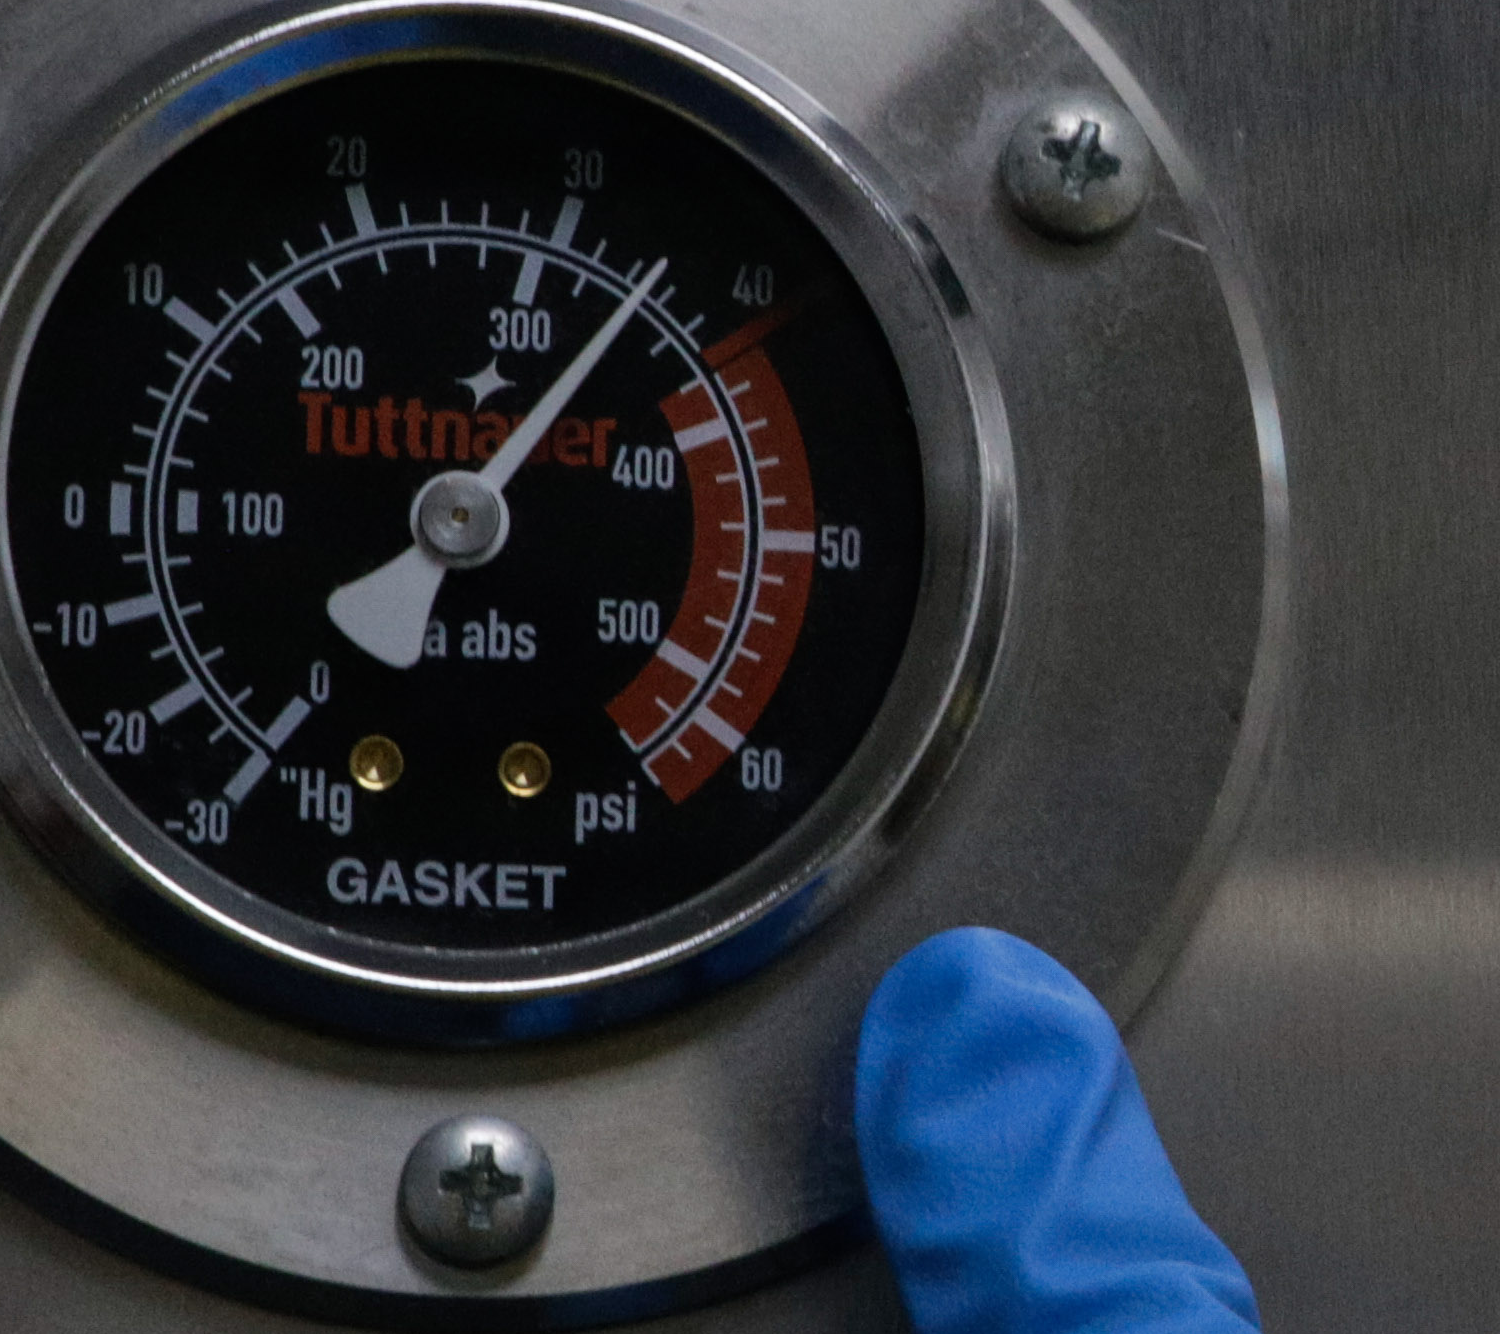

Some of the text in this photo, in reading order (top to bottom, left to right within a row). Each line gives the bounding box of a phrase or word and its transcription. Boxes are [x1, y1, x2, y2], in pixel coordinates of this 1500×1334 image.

[327, 135, 367, 177] 20
[564, 148, 603, 190] 30
[124, 263, 163, 306] 10
[732, 264, 773, 306] 40
[489, 308, 551, 352] 300
[301, 347, 363, 389] 200
[299, 392, 617, 468] Tuttnaer
[612, 446, 675, 489] 400
[65, 483, 85, 527] 0
[223, 492, 284, 536] 100
[821, 526, 860, 569] 50
[33, 603, 96, 646] -10
[461, 607, 537, 662] abs
[599, 600, 659, 644] 500
[310, 660, 330, 704] 0
[83, 710, 146, 754] -20
[741, 748, 782, 792] 60
[165, 801, 229, 844] -30
[575, 782, 637, 845] psi
[327, 858, 566, 910] GASKET
